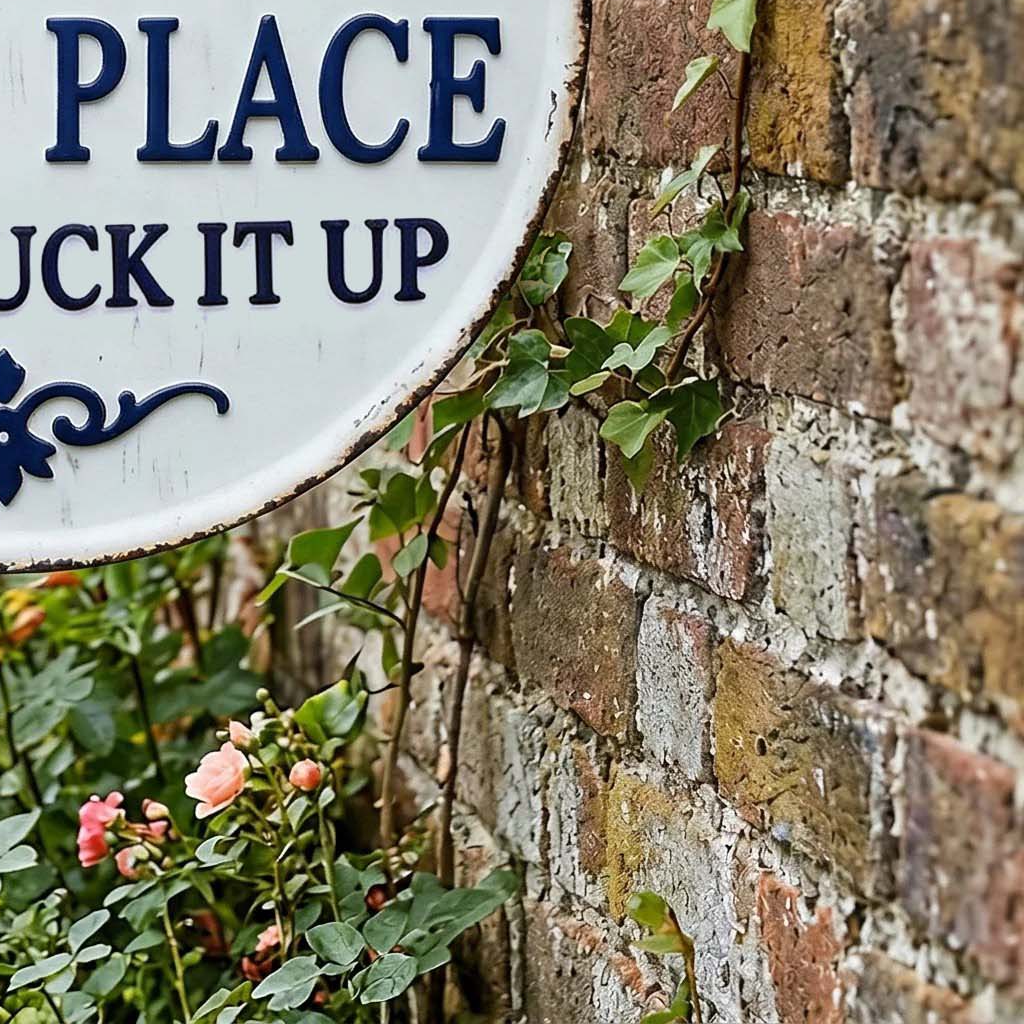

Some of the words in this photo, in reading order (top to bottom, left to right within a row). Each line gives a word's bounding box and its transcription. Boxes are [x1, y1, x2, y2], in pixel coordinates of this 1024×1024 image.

[45, 13, 507, 166] PLACE
[197, 220, 294, 307] IT
[319, 217, 450, 305] UP
